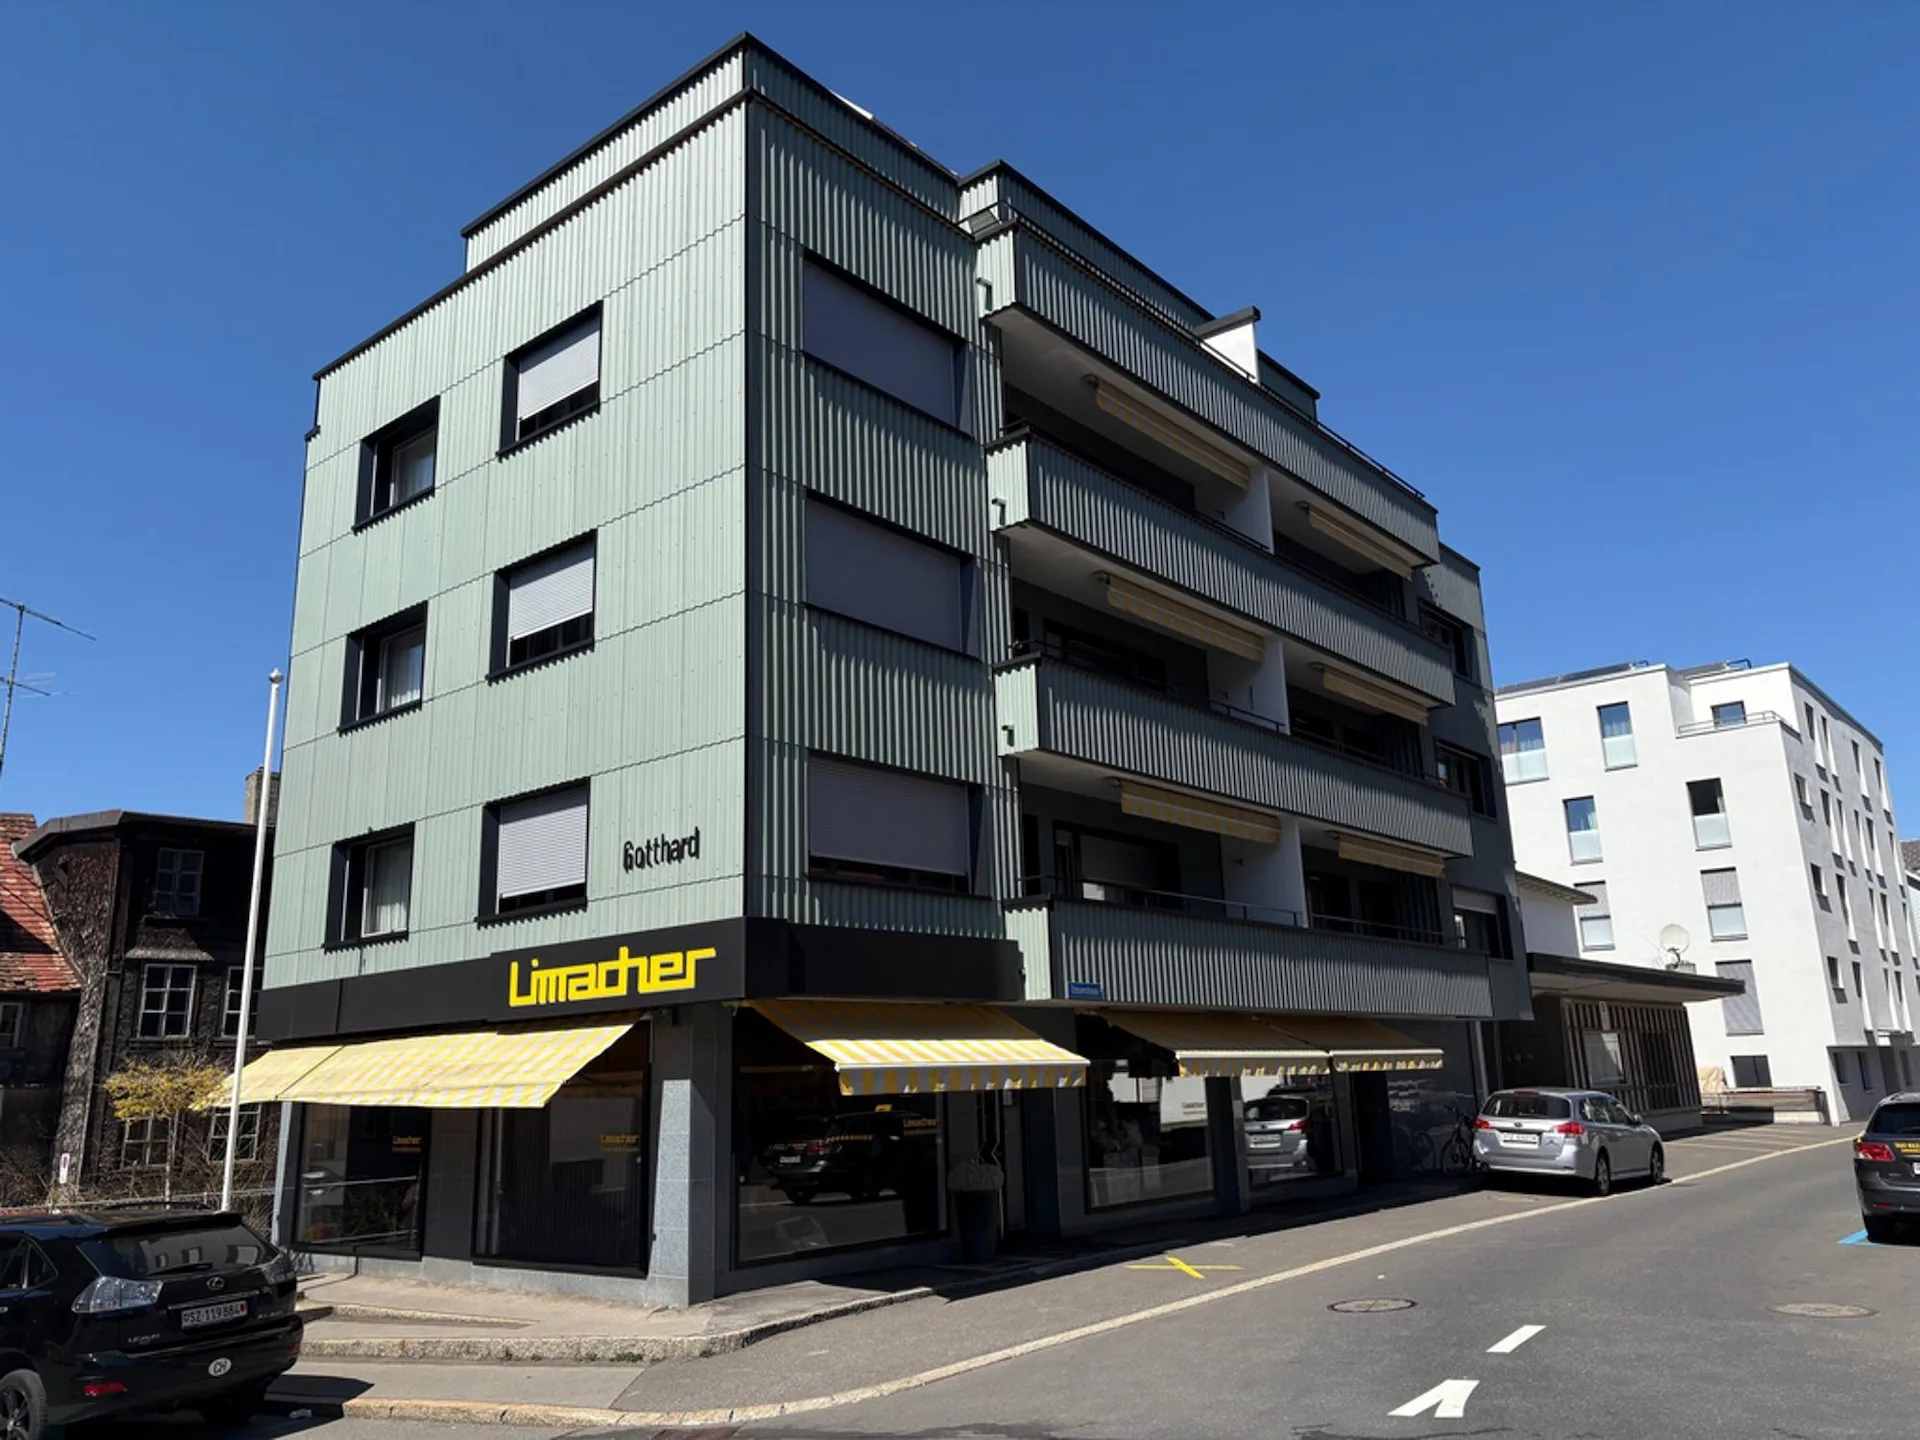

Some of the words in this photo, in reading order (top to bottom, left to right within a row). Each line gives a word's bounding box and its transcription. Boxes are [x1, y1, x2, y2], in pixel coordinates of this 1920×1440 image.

[623, 827, 700, 872] Gotthard
[509, 946, 717, 1007] Limacher
[212, 1359, 228, 1374] CH
